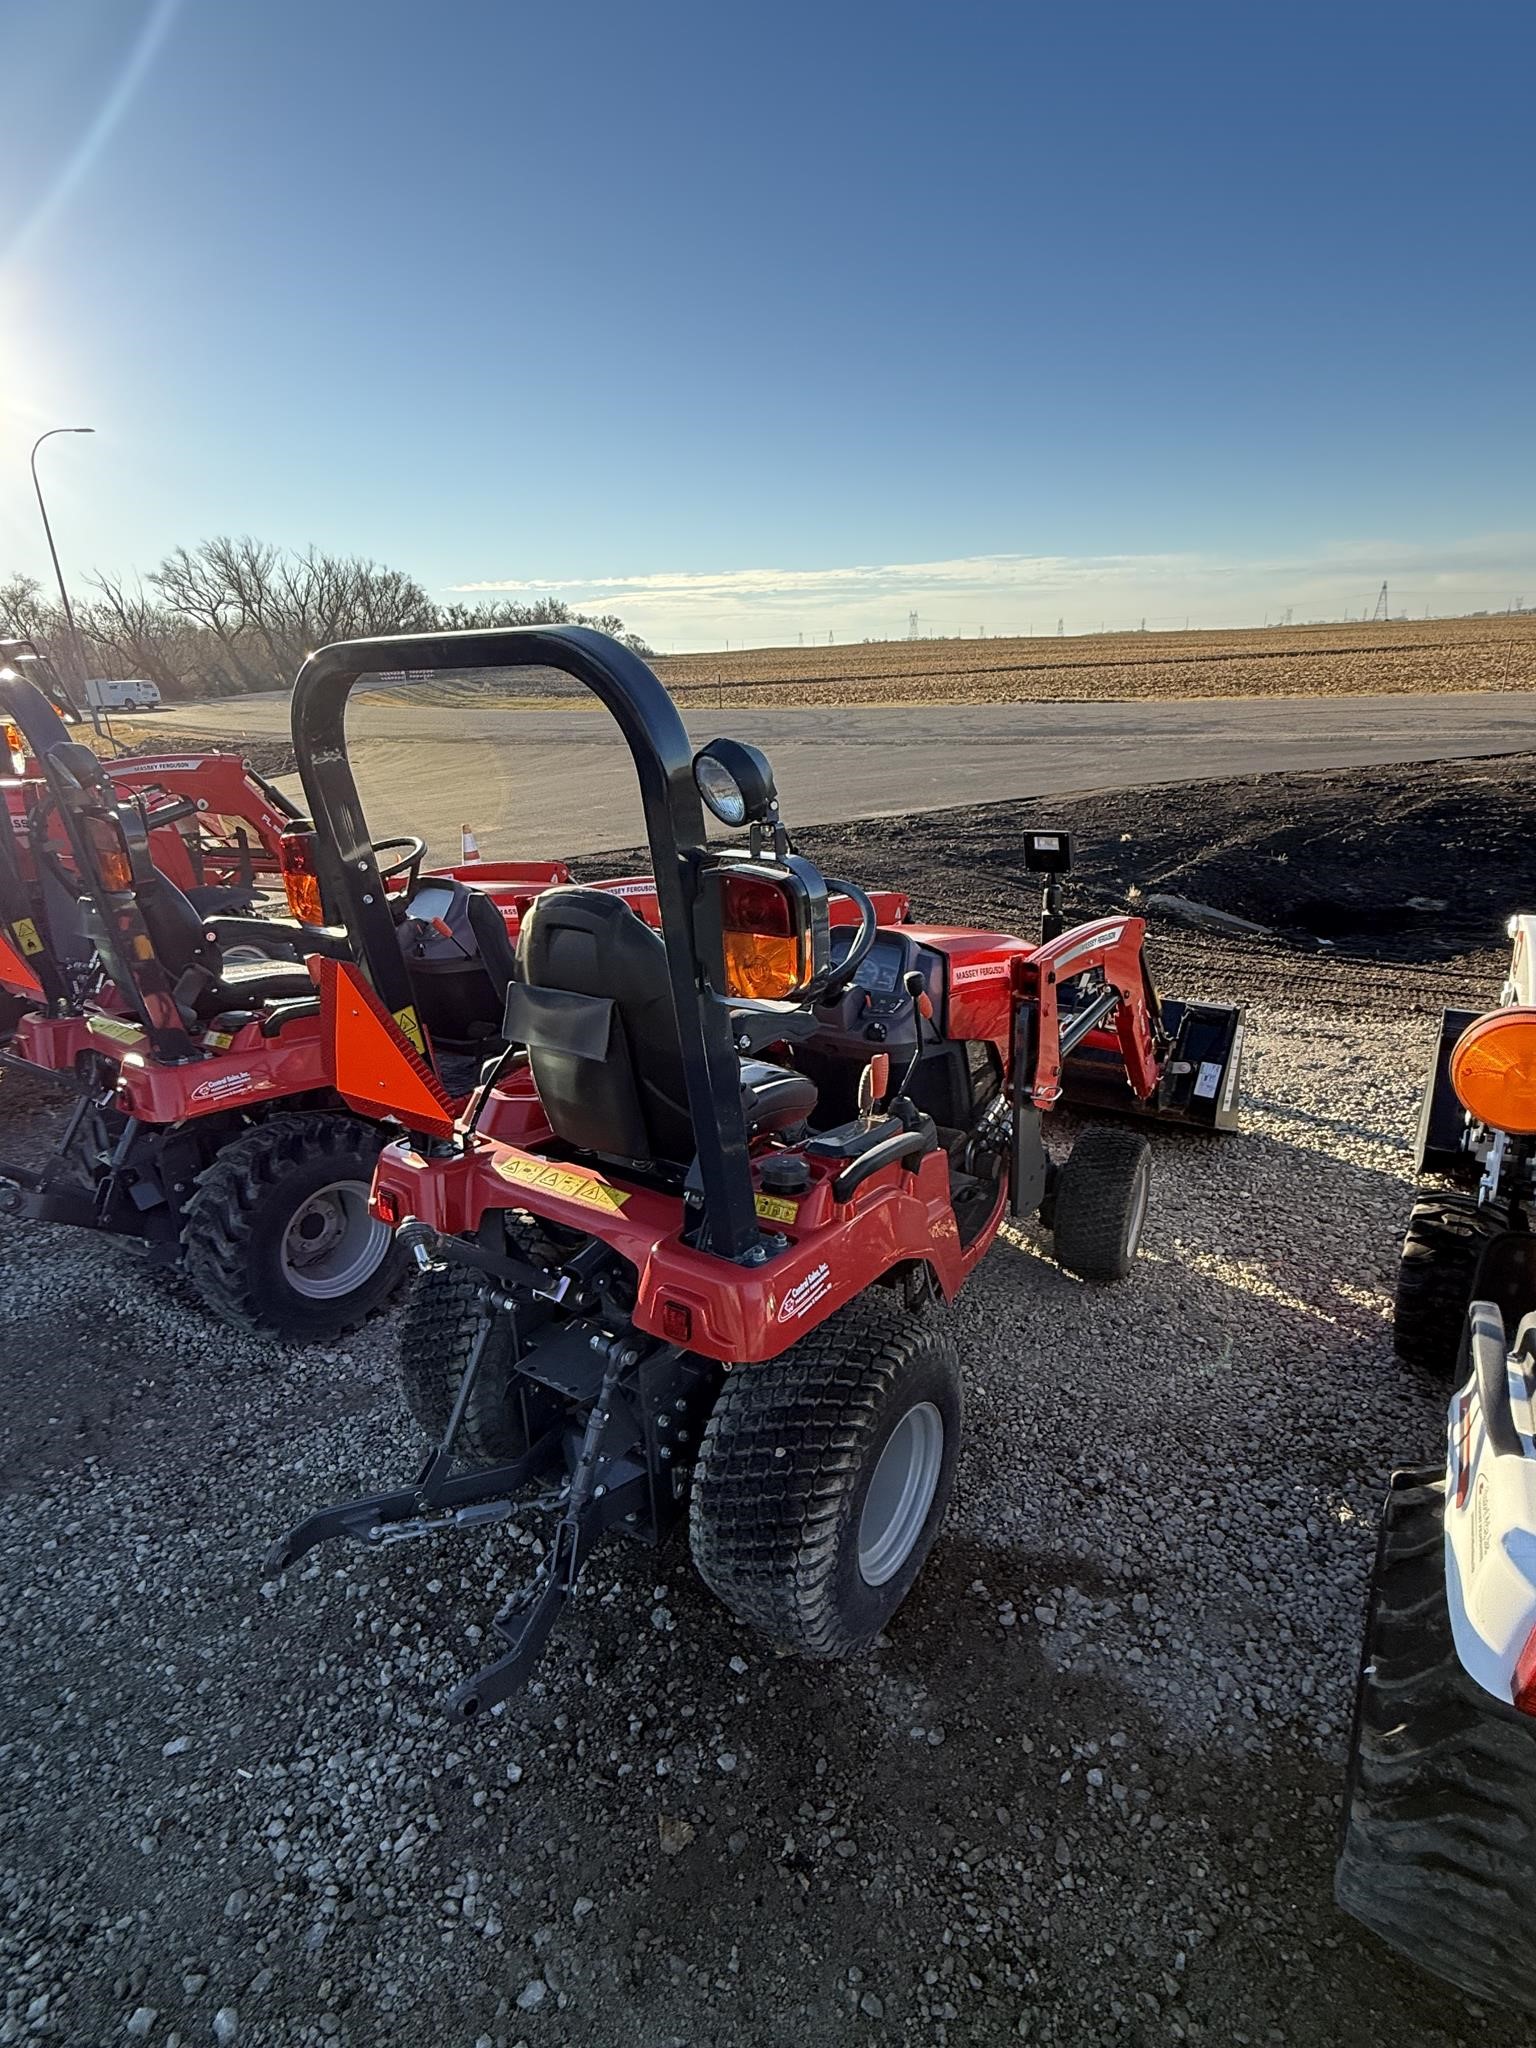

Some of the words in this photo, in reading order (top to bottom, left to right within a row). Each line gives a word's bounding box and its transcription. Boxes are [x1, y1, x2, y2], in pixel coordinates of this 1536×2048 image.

[626, 885, 657, 893] FERGUSON
[956, 969, 979, 980] MASSEY
[979, 966, 1005, 976] FERGUSON
